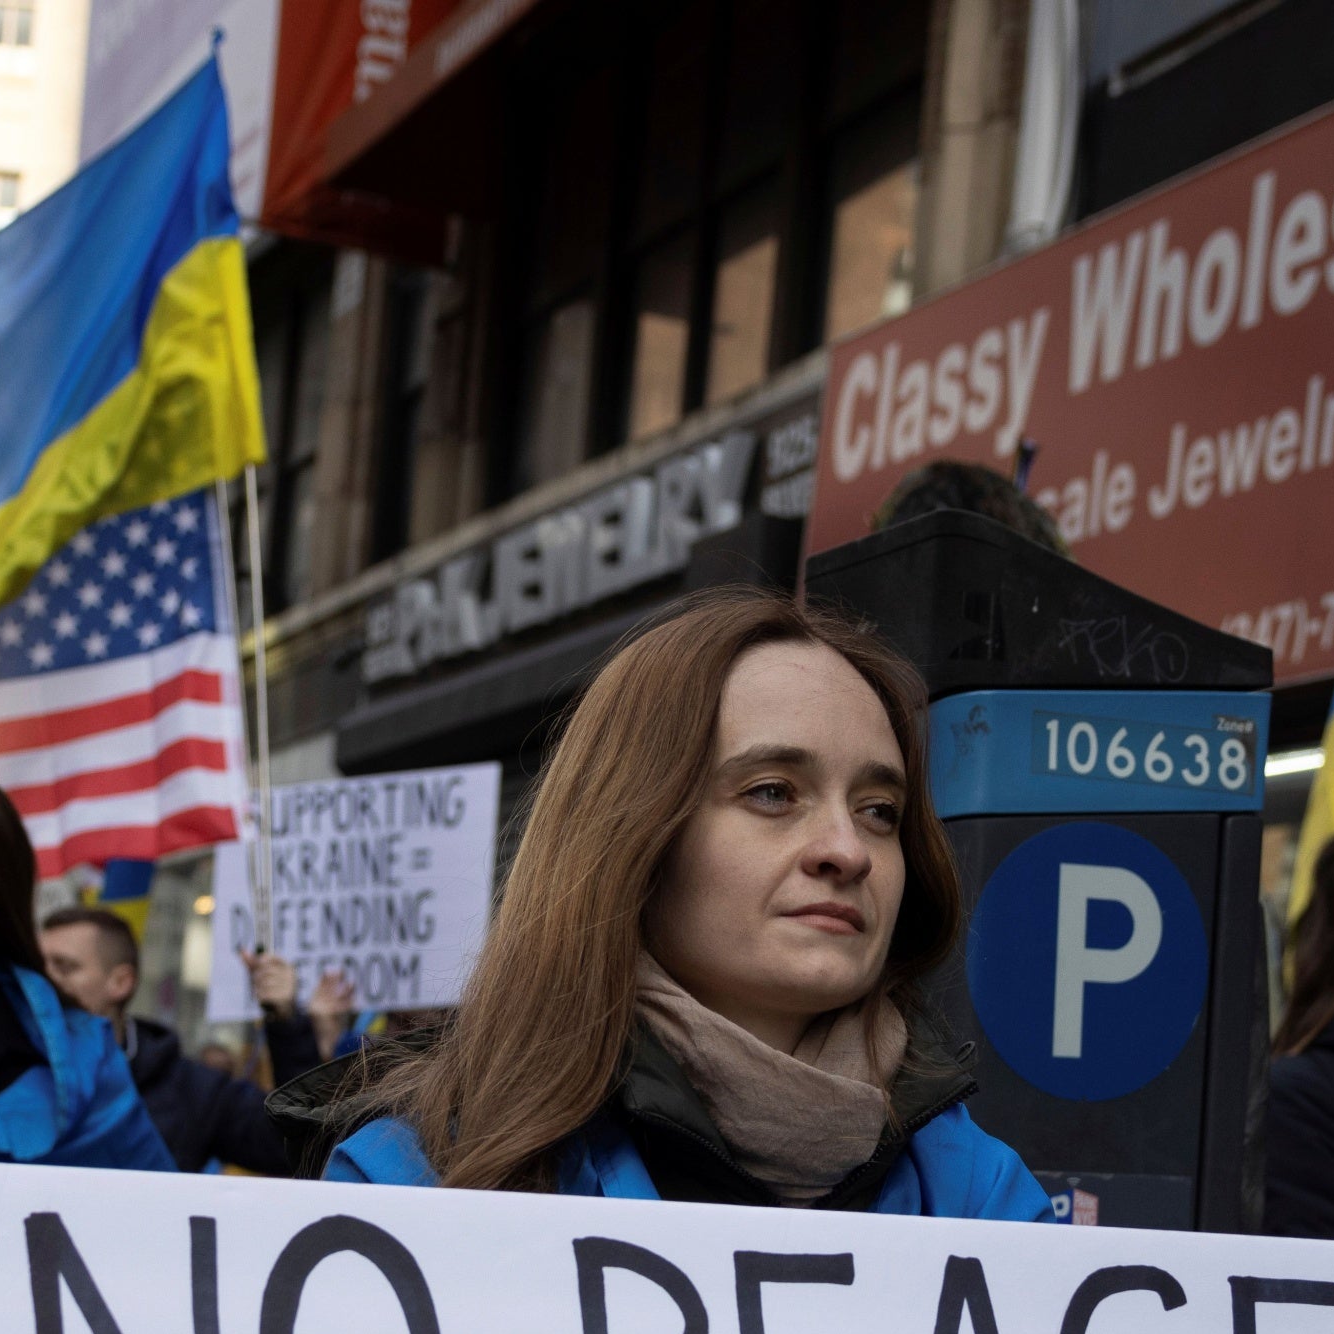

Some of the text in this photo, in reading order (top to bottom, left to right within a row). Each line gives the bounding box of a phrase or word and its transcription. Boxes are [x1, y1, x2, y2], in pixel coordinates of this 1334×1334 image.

[832, 307, 1050, 484] Classy
[1046, 719, 1248, 790] 106638
[1216, 716, 1255, 734] Zone#
[249, 833, 404, 894] KRAINE
[229, 888, 437, 953] DFENDING
[1052, 861, 1164, 1059] P
